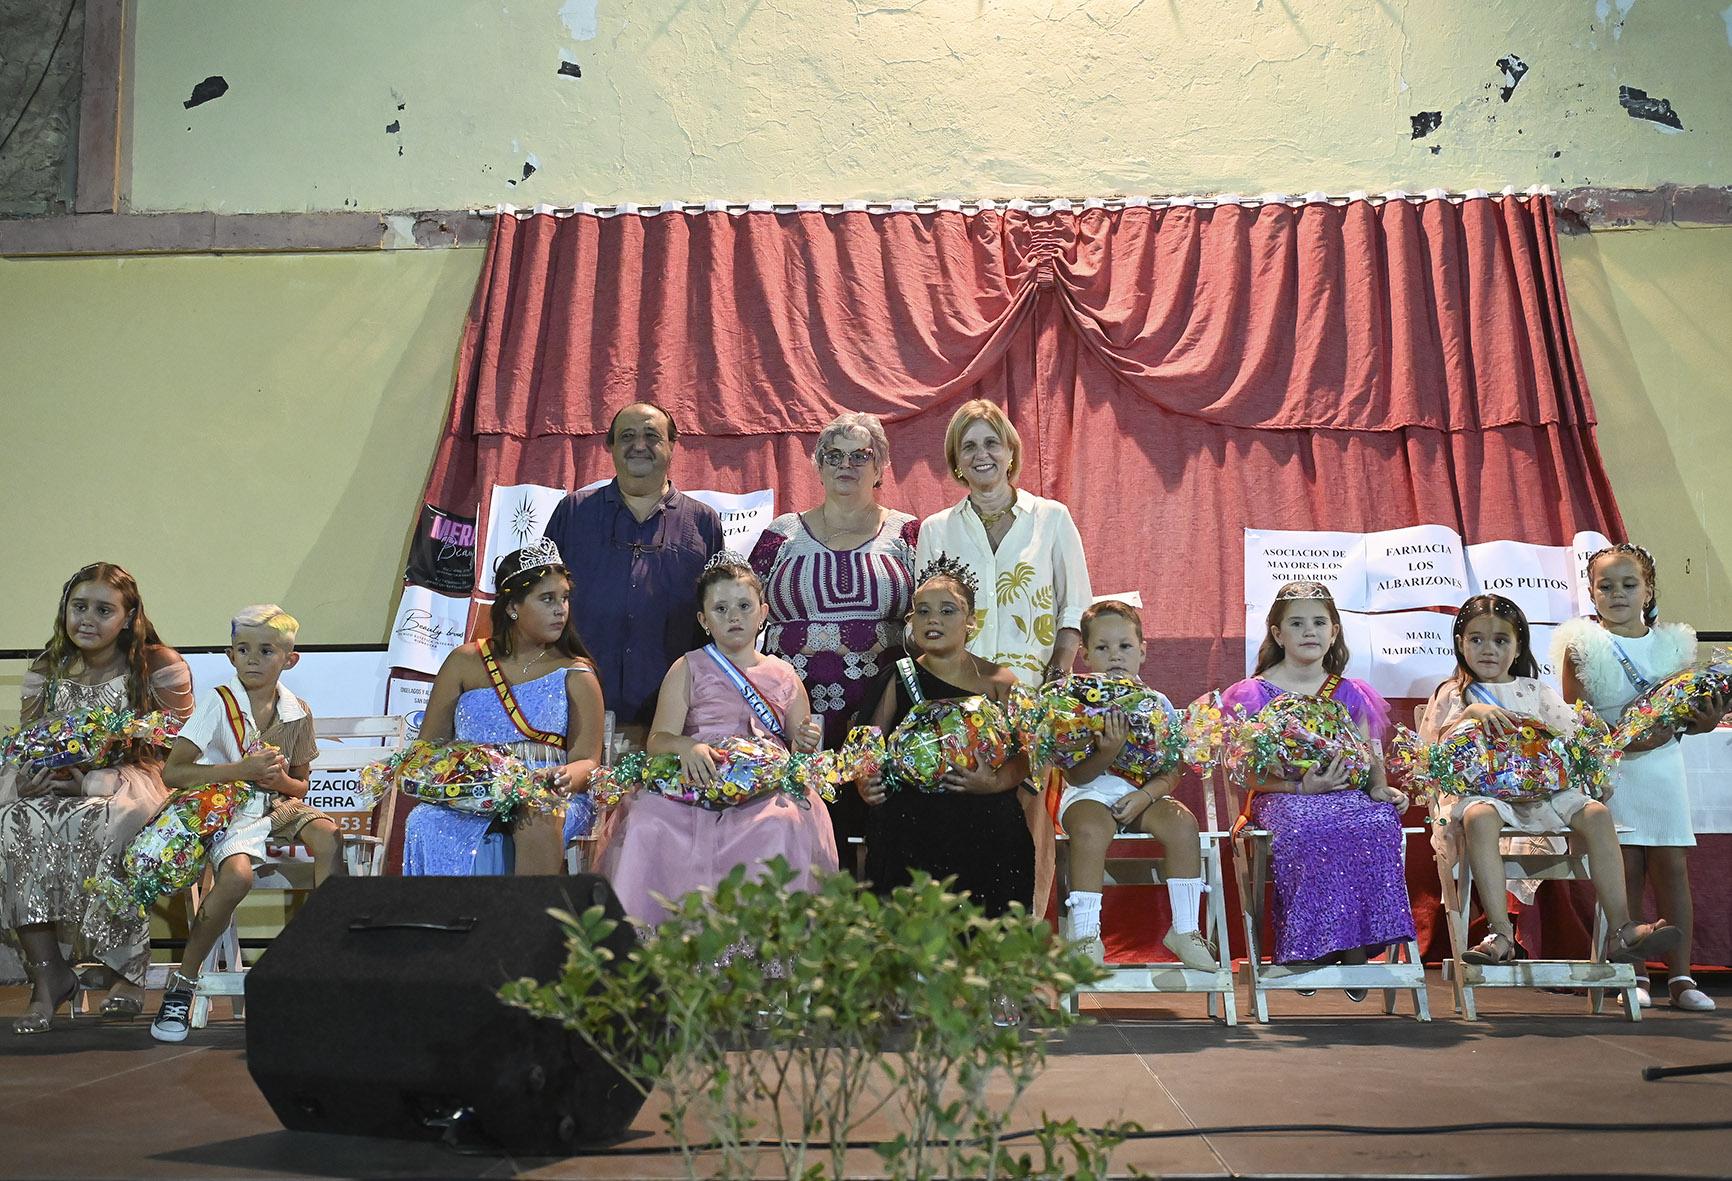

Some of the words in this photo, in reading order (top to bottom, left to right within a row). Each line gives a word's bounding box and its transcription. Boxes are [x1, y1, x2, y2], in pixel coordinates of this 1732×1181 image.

[719, 510, 757, 521] UTIVO
[723, 525, 750, 537] RTAL
[1263, 549, 1329, 557] ASOCIACION
[1332, 550, 1346, 558] DE
[1386, 543, 1452, 556] FARMACIA
[1267, 561, 1319, 569] MAYORES
[1322, 562, 1343, 570] LOS
[1408, 560, 1434, 571] LOS
[1272, 573, 1338, 581] SOLIDARIOS
[1377, 576, 1462, 591] ALBARIZONES
[1484, 578, 1514, 590] LOS
[1518, 577, 1569, 591] PUITOS
[1406, 631, 1442, 641] MARIA
[1382, 646, 1434, 655] MAIRENA
[484, 654, 517, 716] REINA
[308, 780, 357, 791] IZACIO
